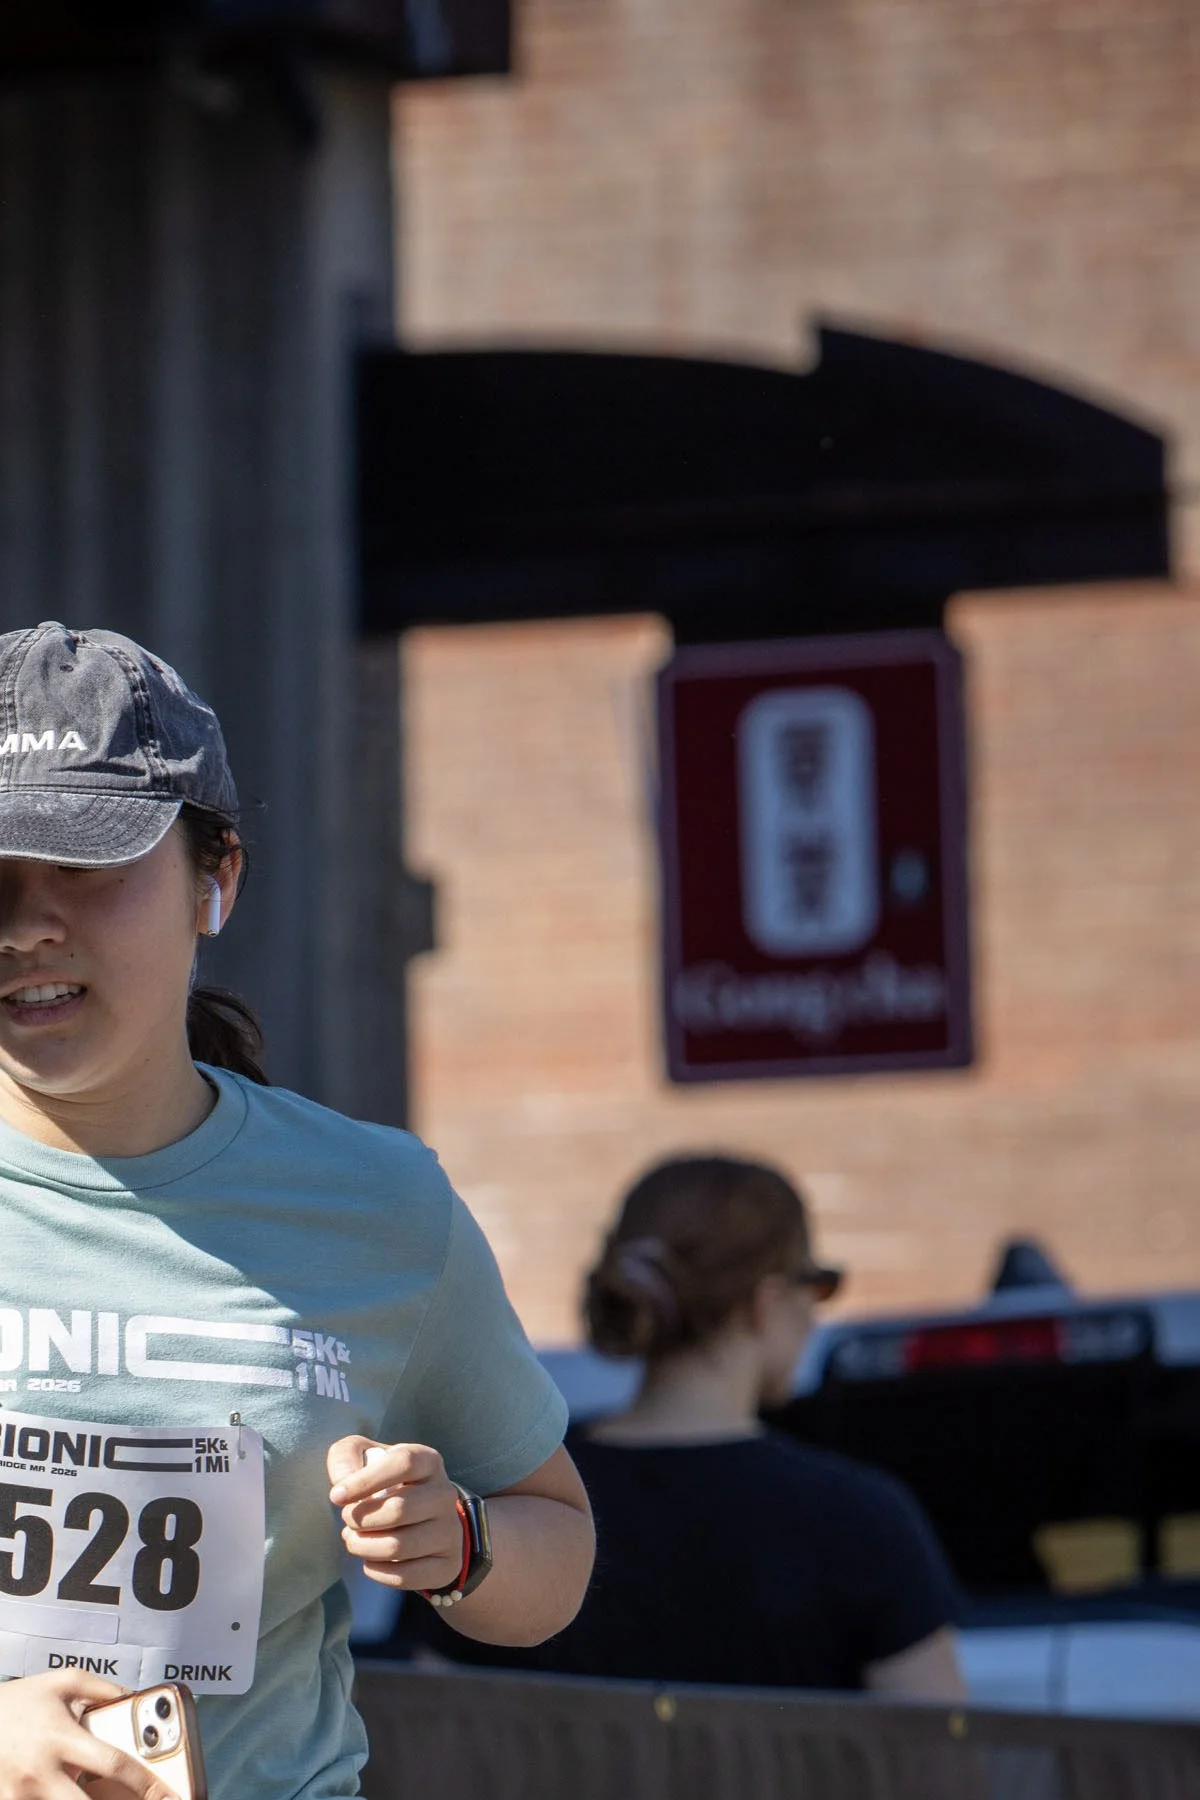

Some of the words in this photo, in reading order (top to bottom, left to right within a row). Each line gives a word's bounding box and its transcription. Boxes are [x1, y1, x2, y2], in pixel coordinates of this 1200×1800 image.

[26, 1378, 81, 1393] 2026
[30, 1464, 46, 1473] MA
[51, 1467, 78, 1477] 2026
[48, 1653, 119, 1676] DRINK
[164, 1664, 233, 1681] DRINK
